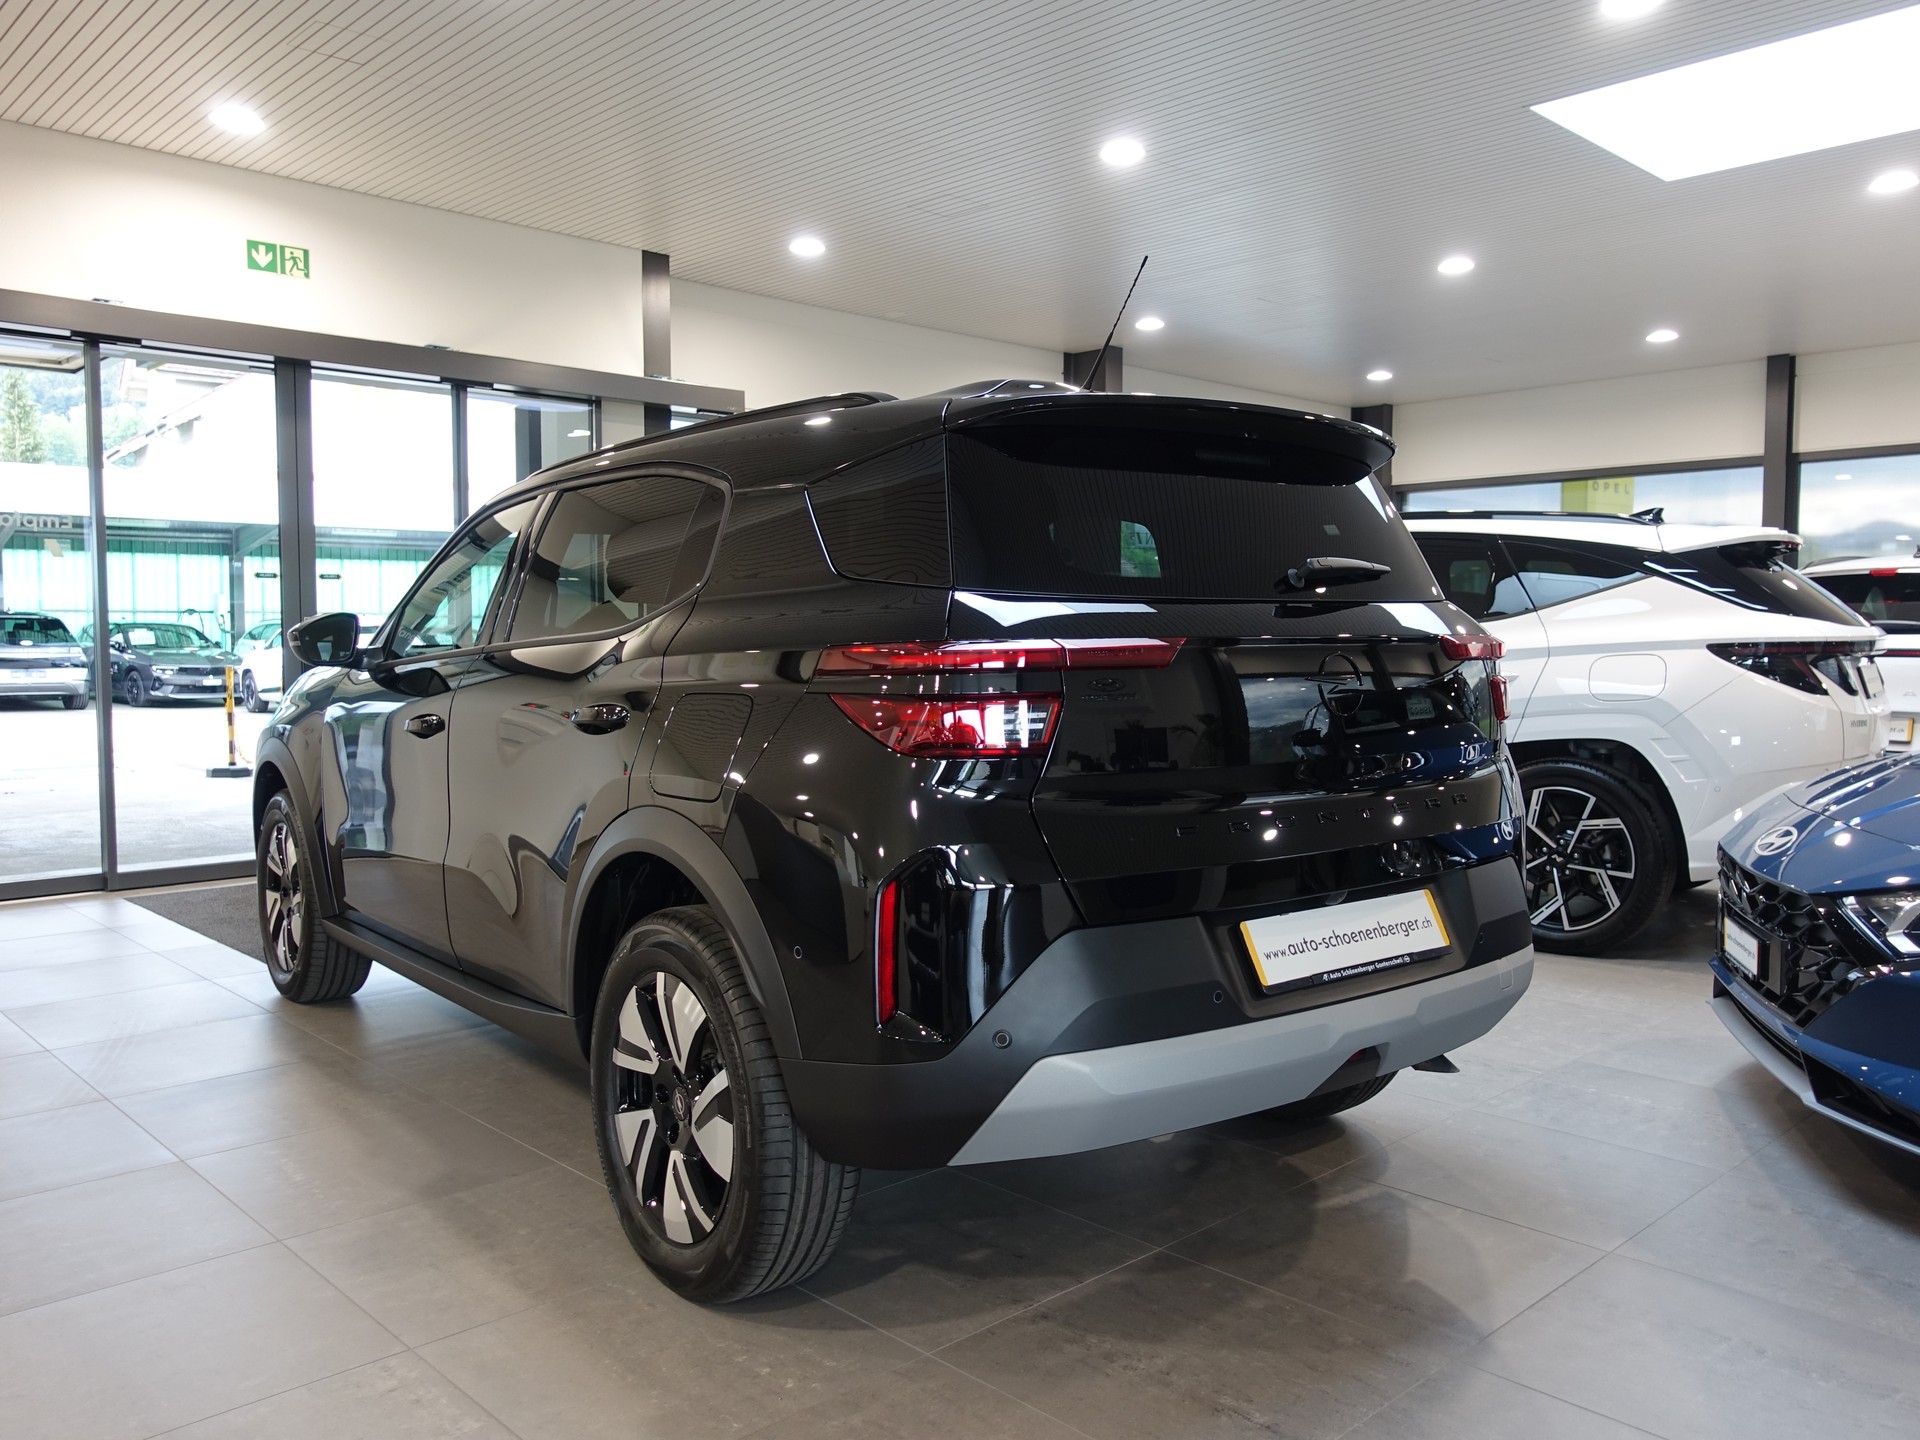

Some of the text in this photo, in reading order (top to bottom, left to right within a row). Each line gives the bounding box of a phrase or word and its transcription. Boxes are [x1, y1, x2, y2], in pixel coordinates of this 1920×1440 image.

[1592, 480, 1630, 494] OPEL
[1175, 792, 1468, 838] FRONTERA
[1264, 917, 1432, 960] www.auto-schoenenberger.ch
